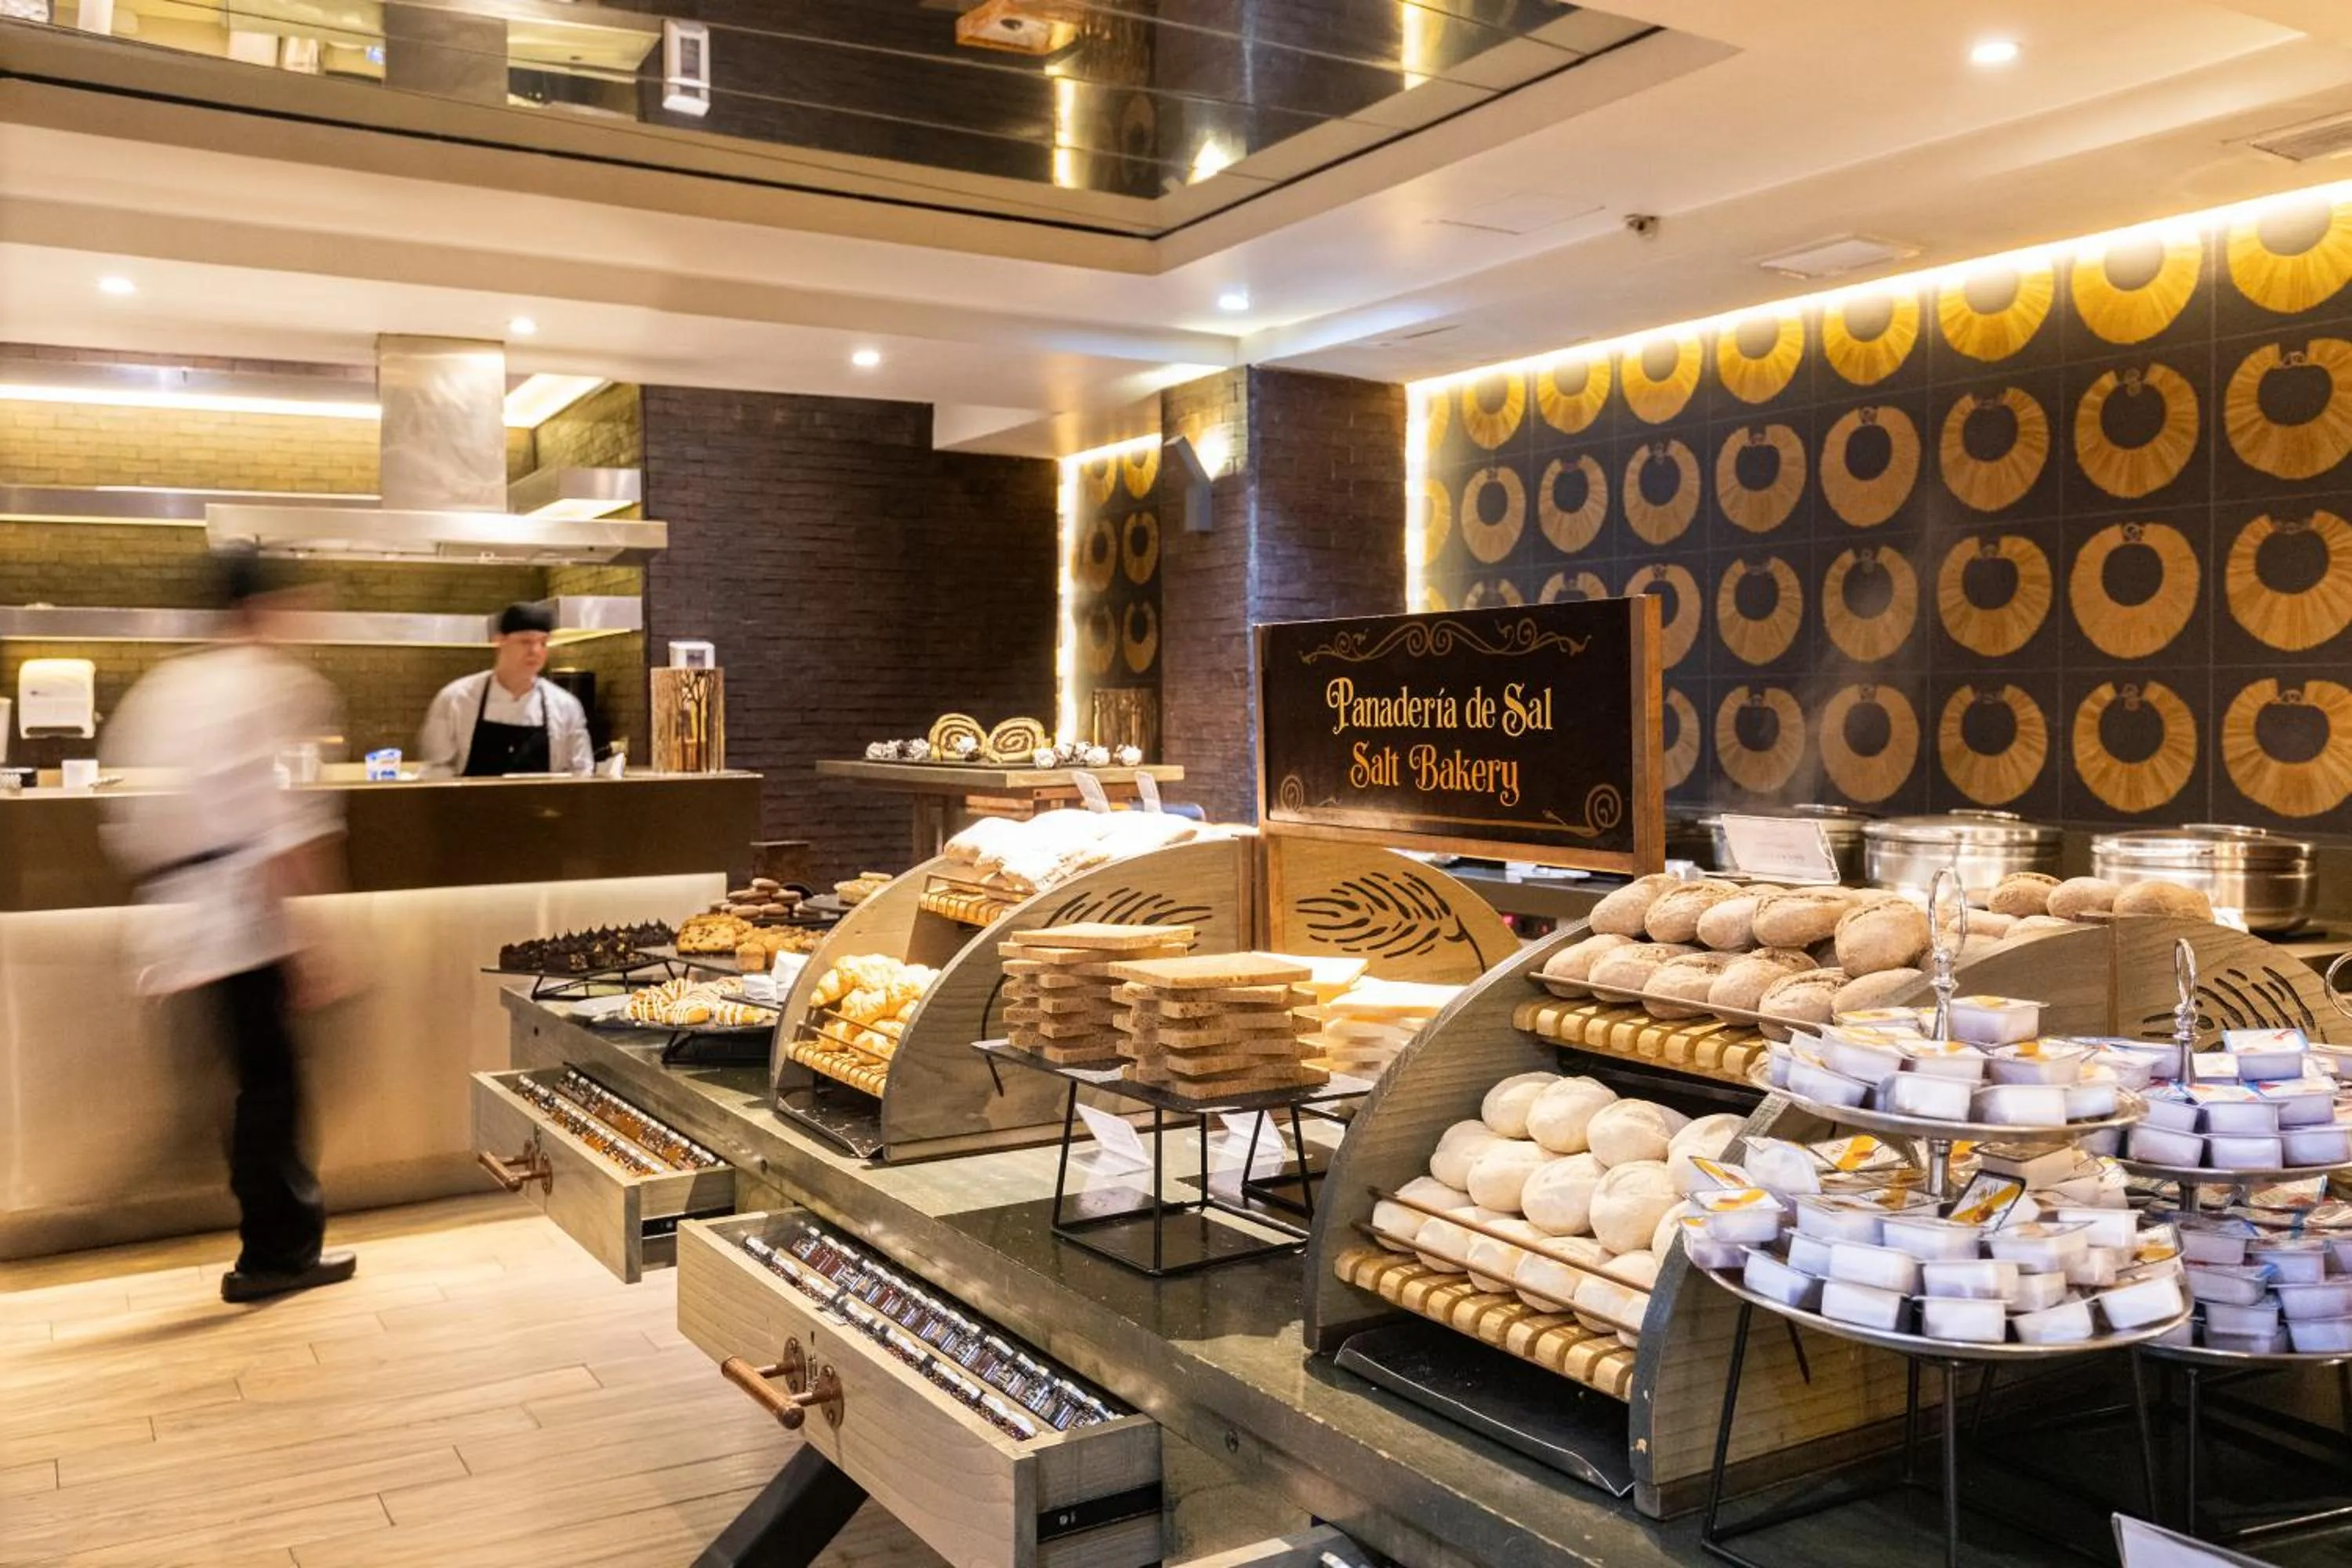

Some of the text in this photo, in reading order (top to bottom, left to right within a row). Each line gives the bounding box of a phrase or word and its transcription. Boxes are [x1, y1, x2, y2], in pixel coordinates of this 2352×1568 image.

[1326, 677, 1553, 737] Panadería de Sal
[1349, 740, 1520, 807] Salt Bakery
